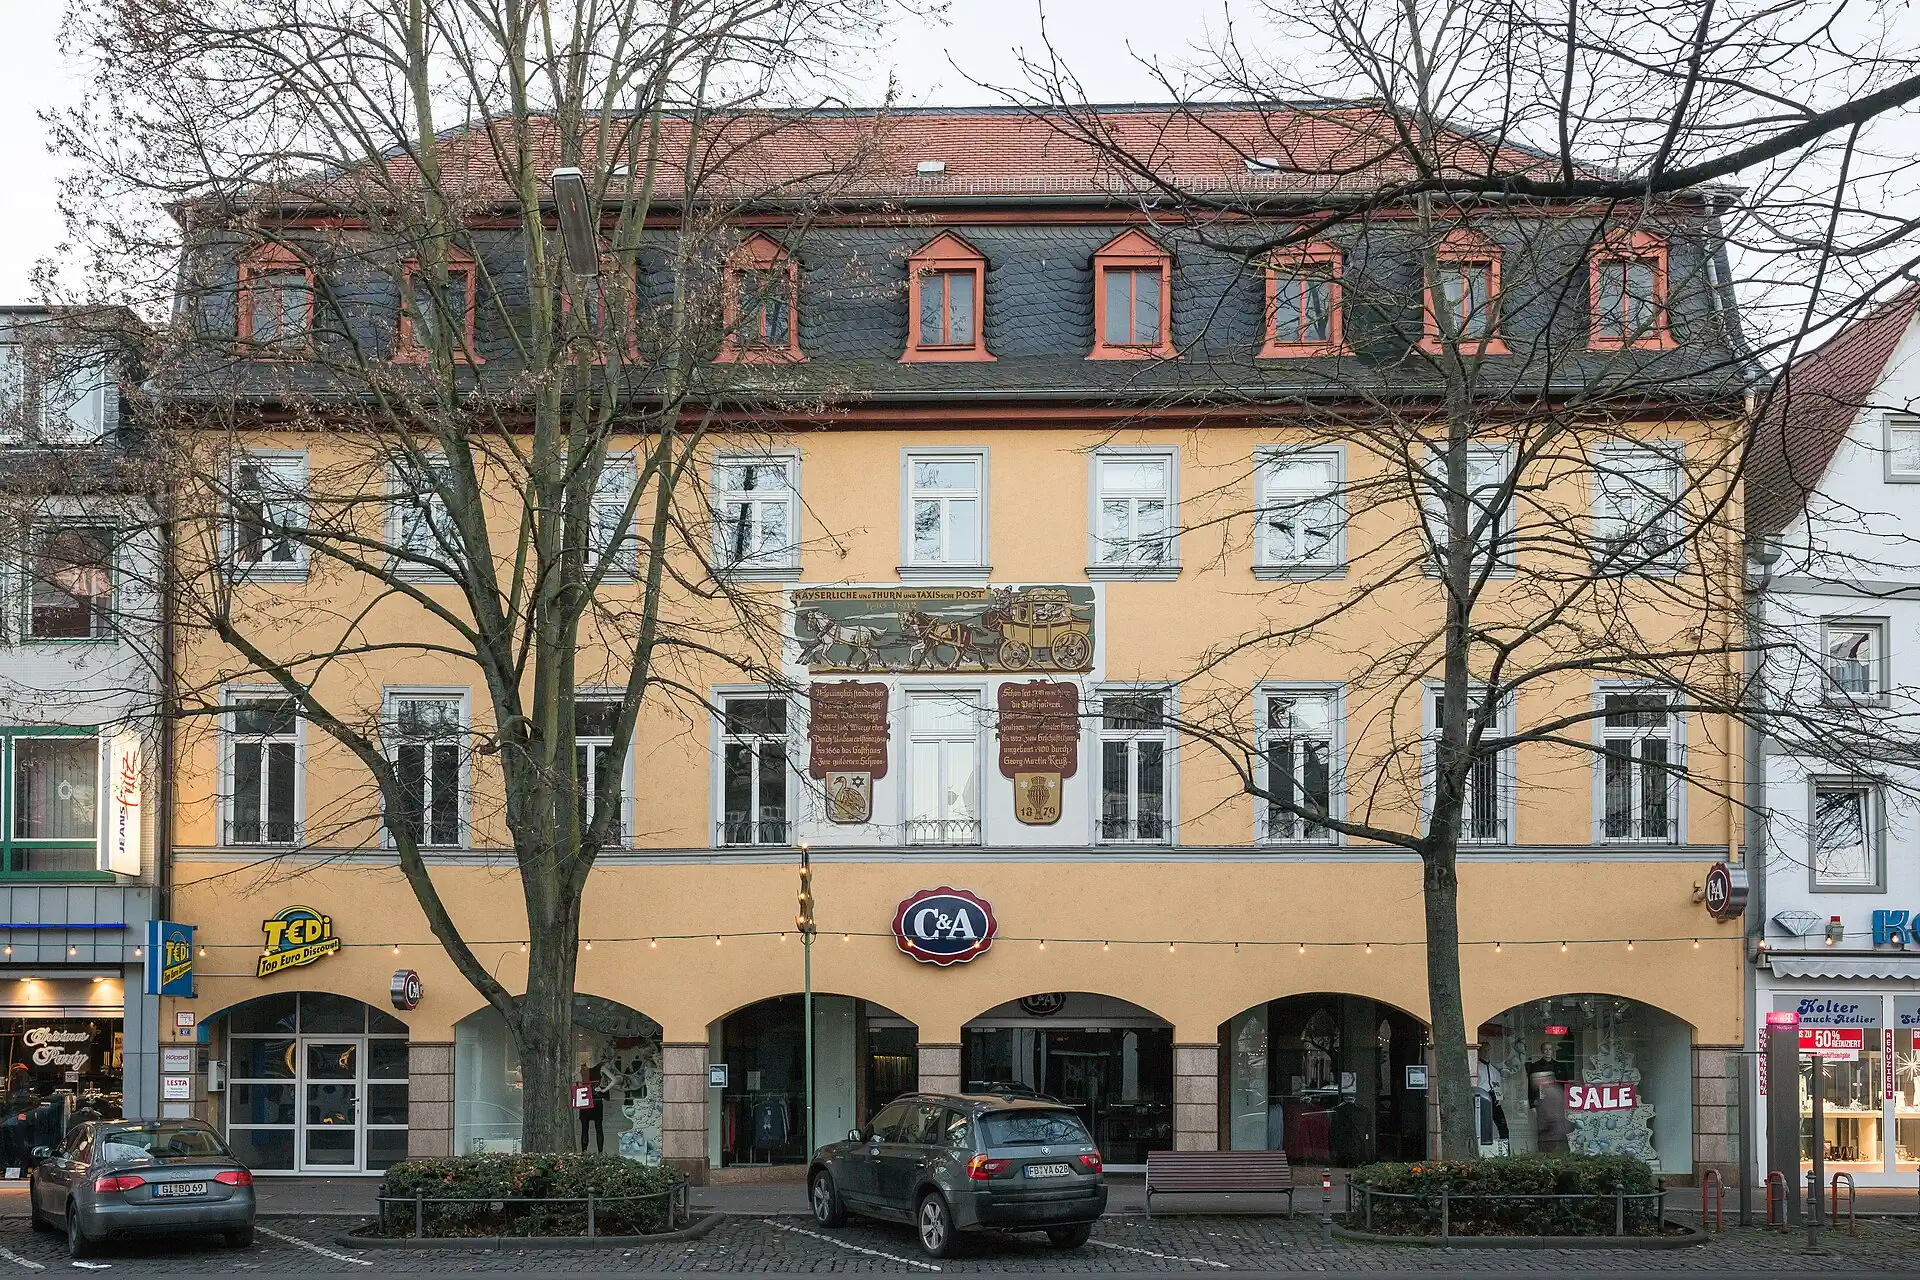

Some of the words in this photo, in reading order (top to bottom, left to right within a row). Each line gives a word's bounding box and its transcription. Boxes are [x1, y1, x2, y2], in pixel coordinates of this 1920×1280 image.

[872, 591, 903, 600] THURN
[956, 590, 986, 599] POST
[1707, 878, 1725, 902] C&A
[914, 908, 977, 940] C&A
[1873, 910, 1920, 944] K
[261, 959, 278, 973] Top
[280, 954, 301, 966] Euro
[408, 981, 420, 998] C&A
[1796, 998, 1858, 1015] Kolter
[1799, 1014, 1875, 1025] muck-Atelier
[1804, 1030, 1812, 1038] ZU
[32, 1046, 88, 1071] Party
[1569, 1086, 1632, 1110] SALE
[1029, 1166, 1040, 1175] FB
[1043, 1165, 1054, 1174] YA
[1054, 1165, 1068, 1174] 628
[162, 1185, 173, 1193] GI
[192, 1184, 203, 1192] 69
